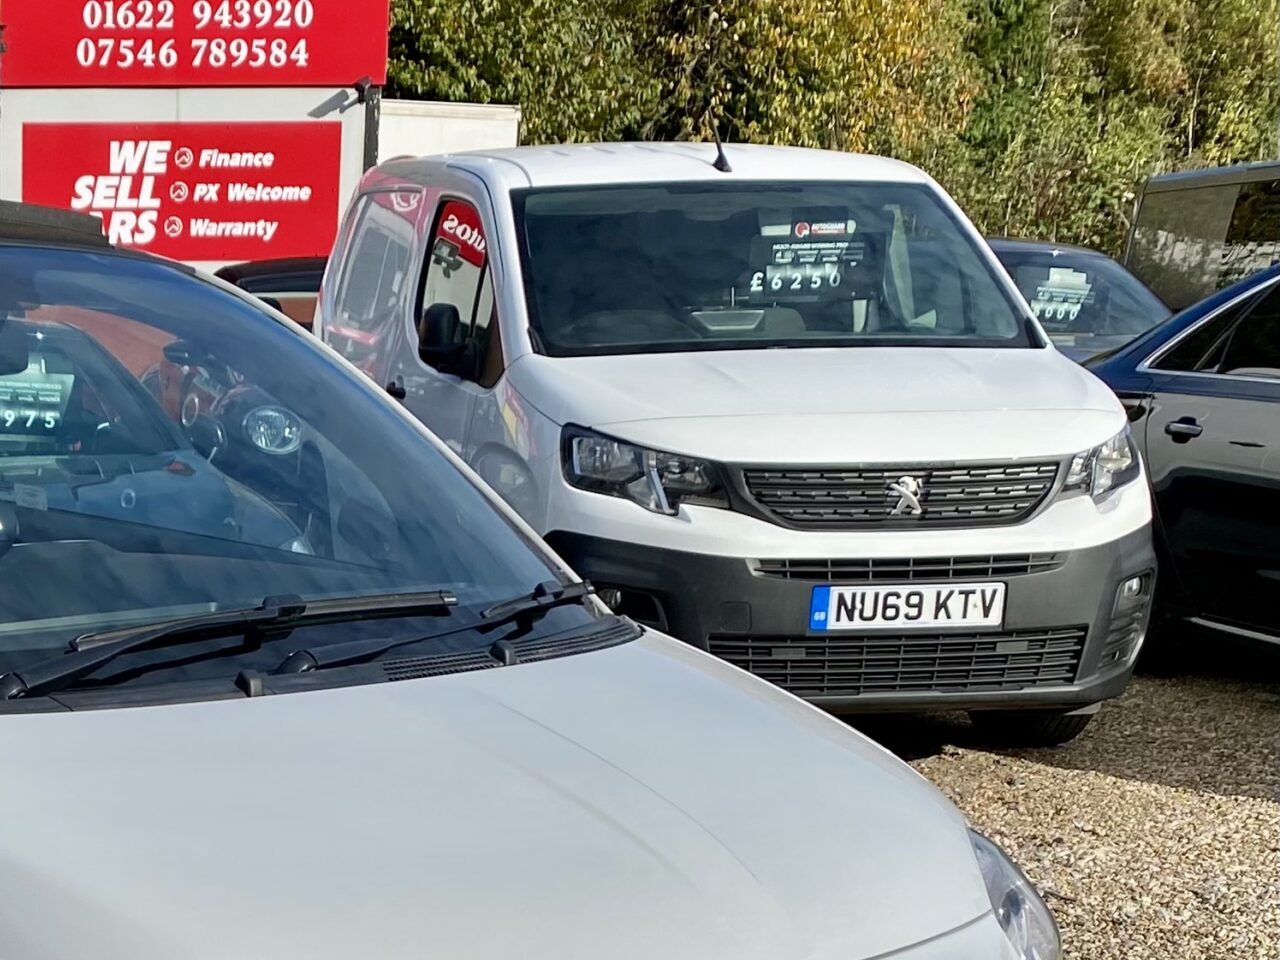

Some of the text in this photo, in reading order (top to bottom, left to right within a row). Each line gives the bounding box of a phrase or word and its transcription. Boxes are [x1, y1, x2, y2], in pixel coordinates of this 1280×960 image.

[83, 0, 314, 30] 01622 943920
[77, 38, 309, 68] 07546 789584
[110, 141, 172, 174] WE
[199, 149, 275, 169] Finance
[71, 174, 161, 210] SELL
[194, 184, 313, 203] PX Welcome
[190, 219, 280, 241] Warranty
[835, 588, 998, 622] NU69 KTV
